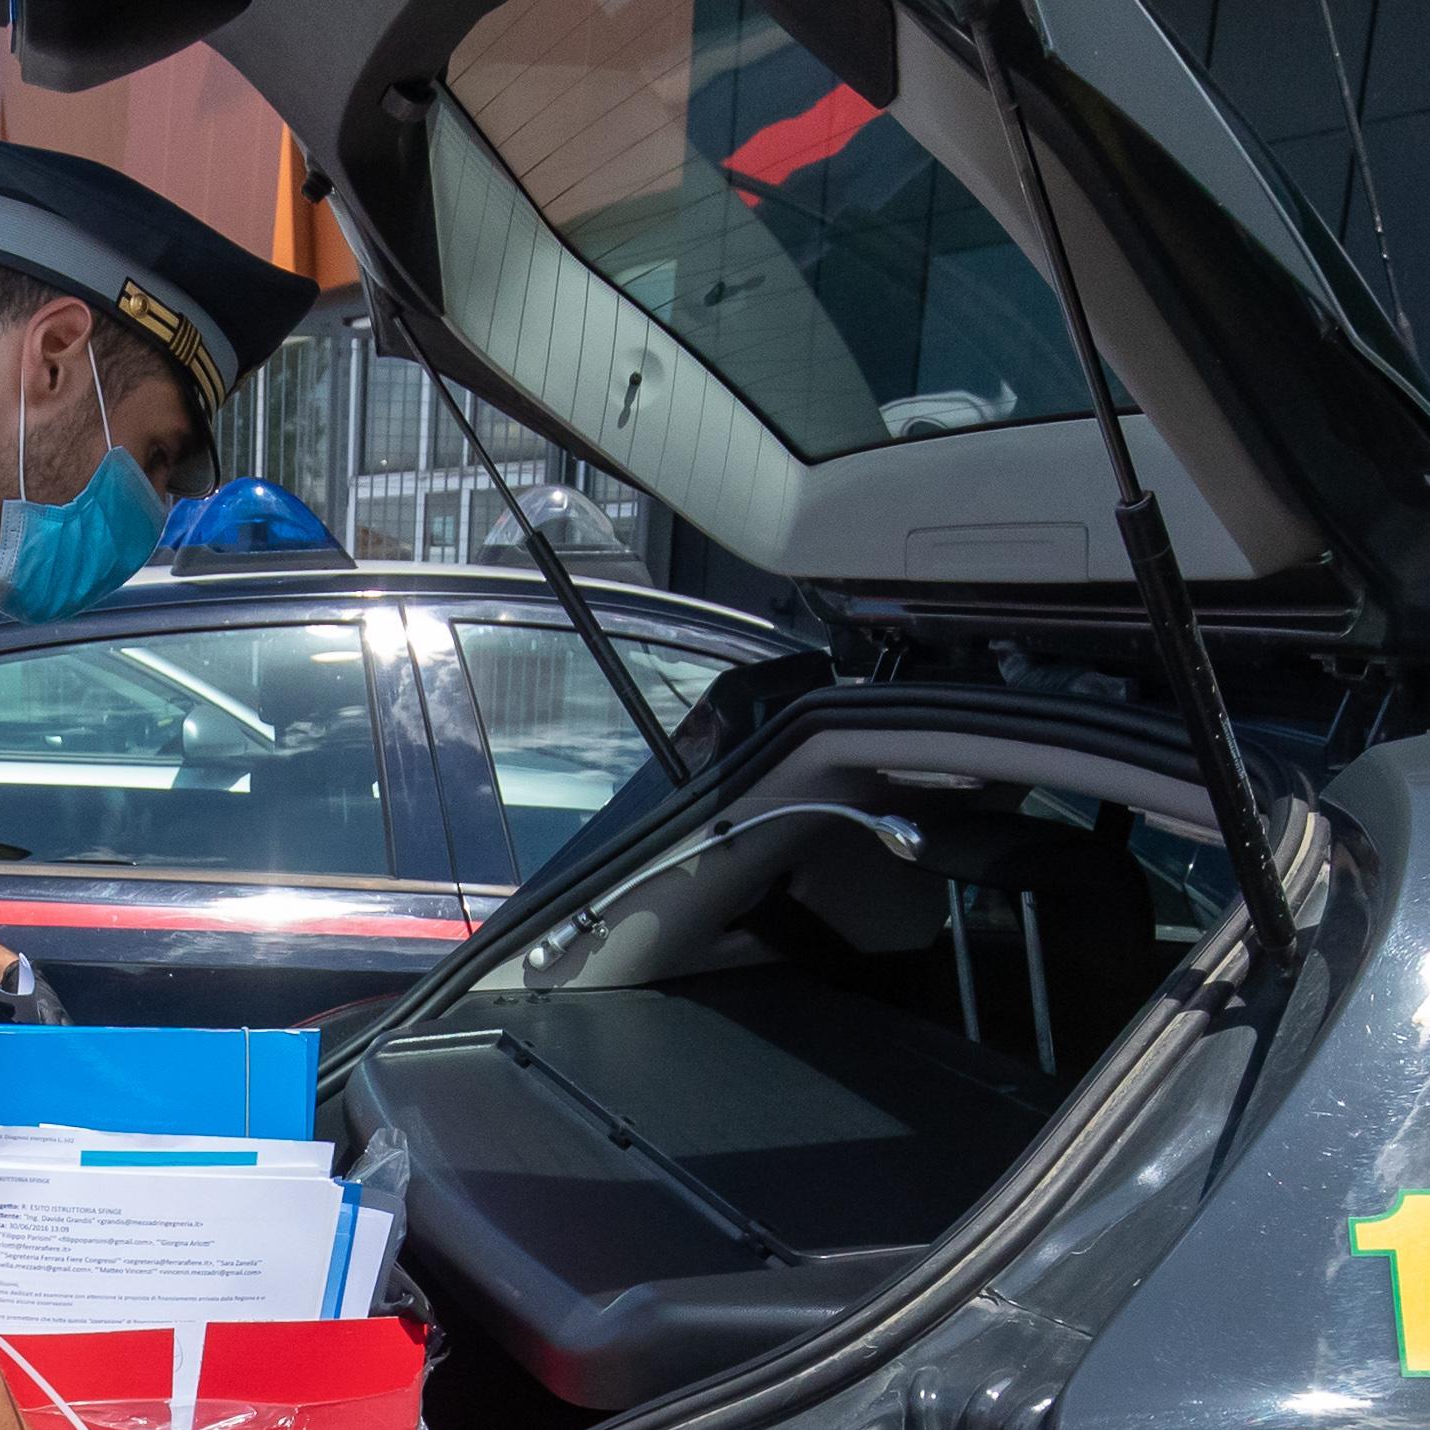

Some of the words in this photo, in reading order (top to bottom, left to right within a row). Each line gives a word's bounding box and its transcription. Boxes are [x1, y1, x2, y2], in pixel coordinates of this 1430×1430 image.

[30, 1204, 51, 1212] ESITO
[51, 1205, 97, 1215] ISTRUTTORIA
[98, 1207, 123, 1216] SFINGE
